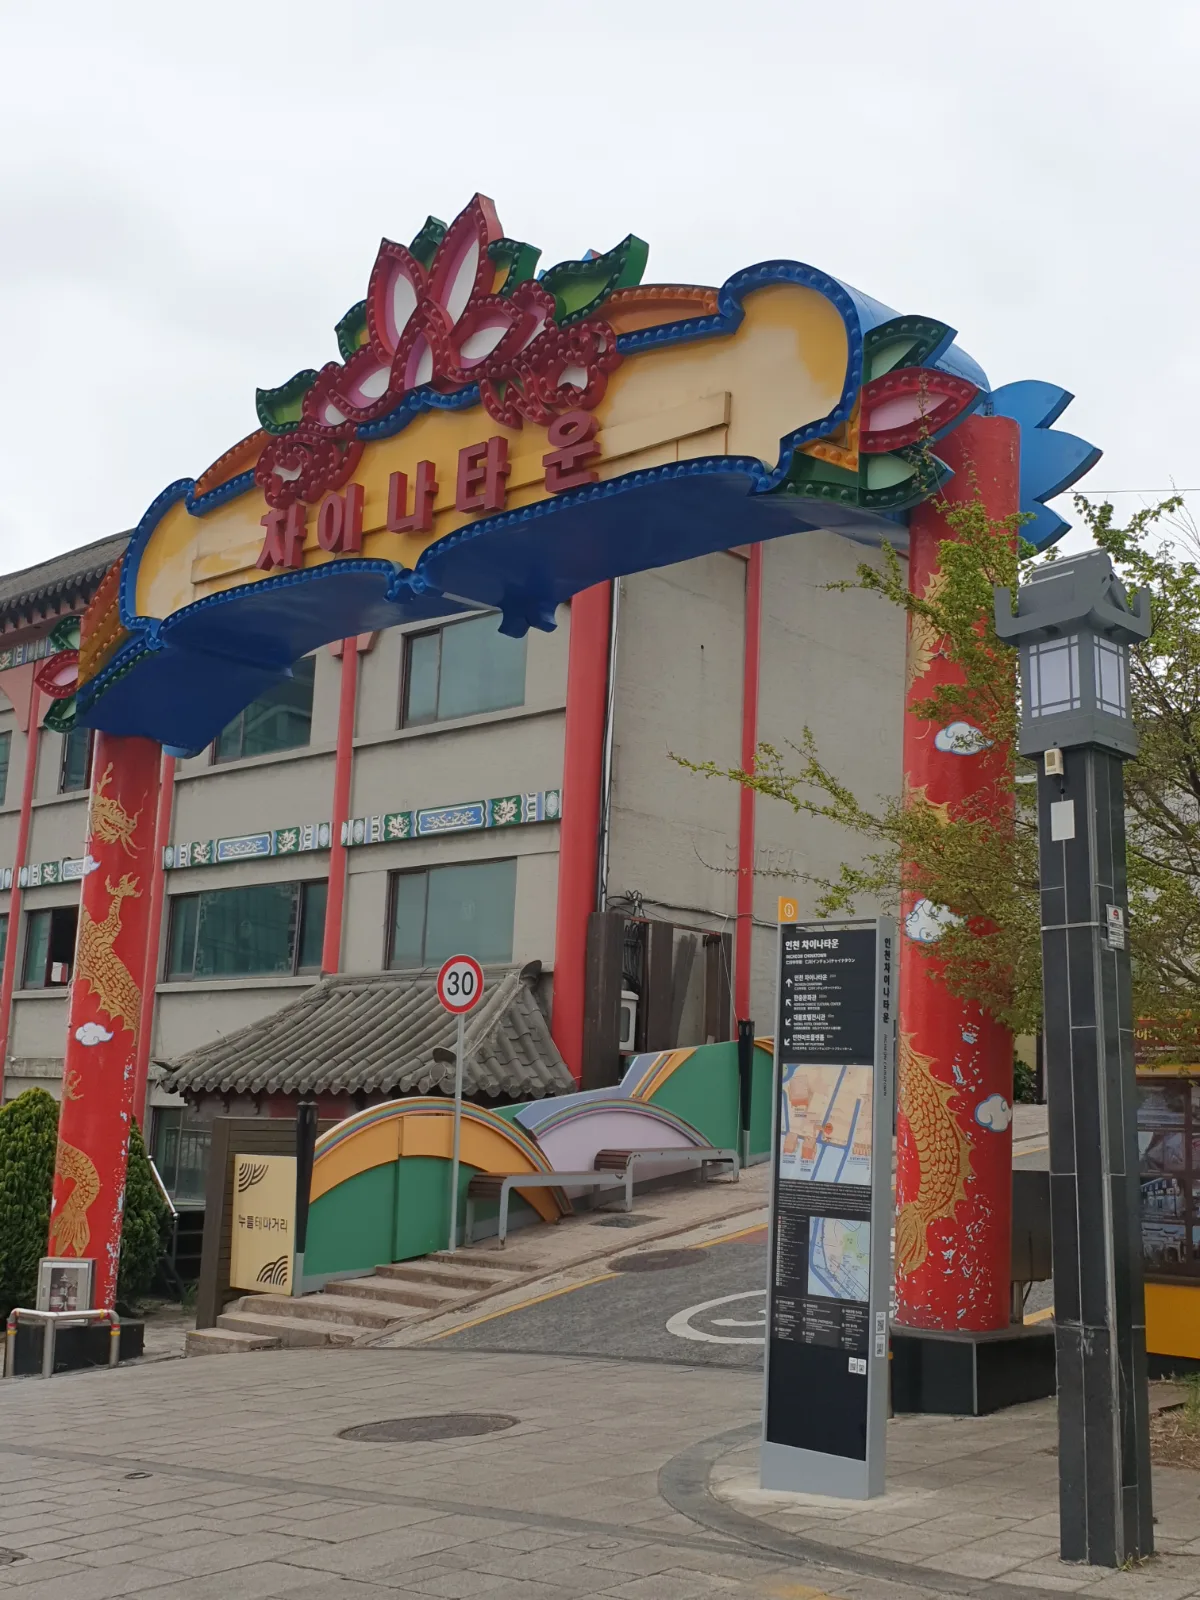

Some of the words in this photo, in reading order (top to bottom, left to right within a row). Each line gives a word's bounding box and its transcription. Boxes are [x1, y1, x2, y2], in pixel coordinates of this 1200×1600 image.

[255, 409, 601, 571] 차이나타운
[785, 940, 800, 951] 인천
[802, 938, 839, 950] 차이나타운
[447, 971, 474, 996] 30
[883, 937, 891, 1024] 인천차이나타운
[238, 1214, 288, 1233] 누들테마거리
